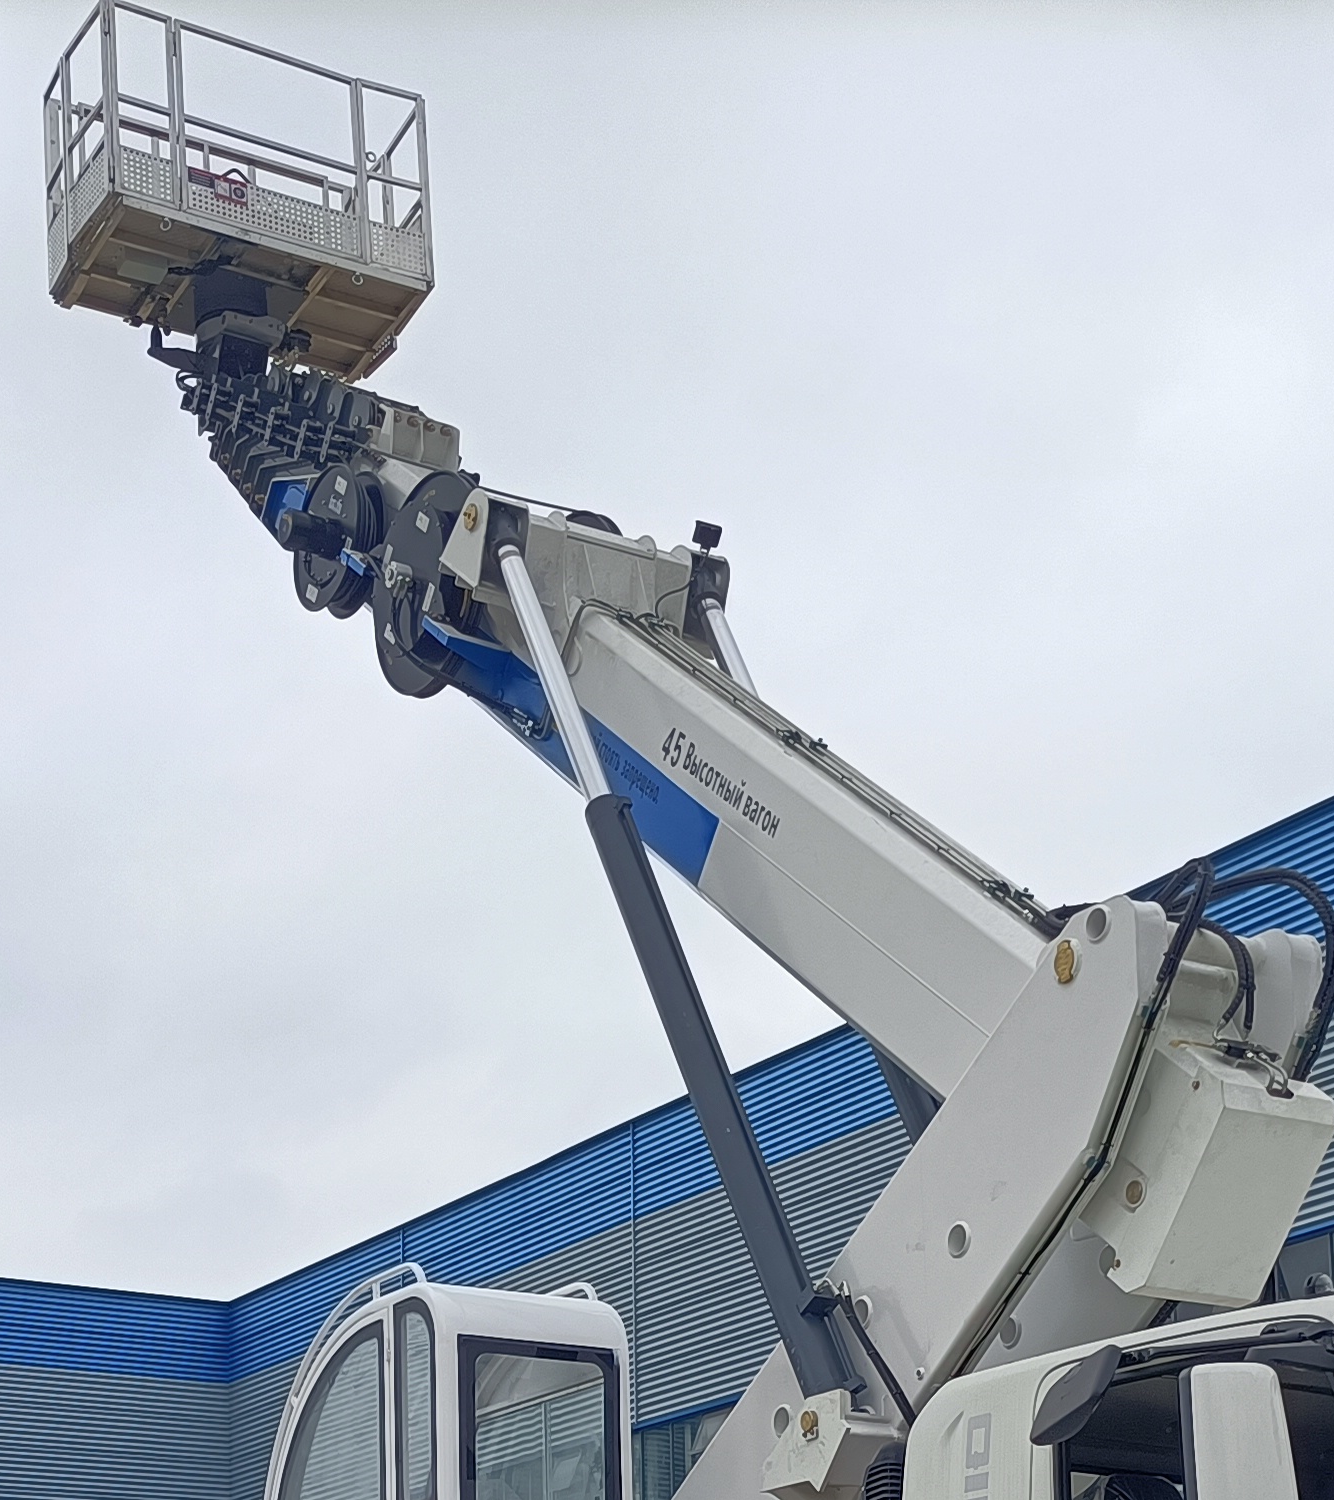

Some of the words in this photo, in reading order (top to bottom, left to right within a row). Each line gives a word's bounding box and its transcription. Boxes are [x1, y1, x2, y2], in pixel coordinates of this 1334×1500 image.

[662, 727, 687, 768] 45
[682, 741, 746, 812] Высотный
[742, 794, 781, 838] вагон
